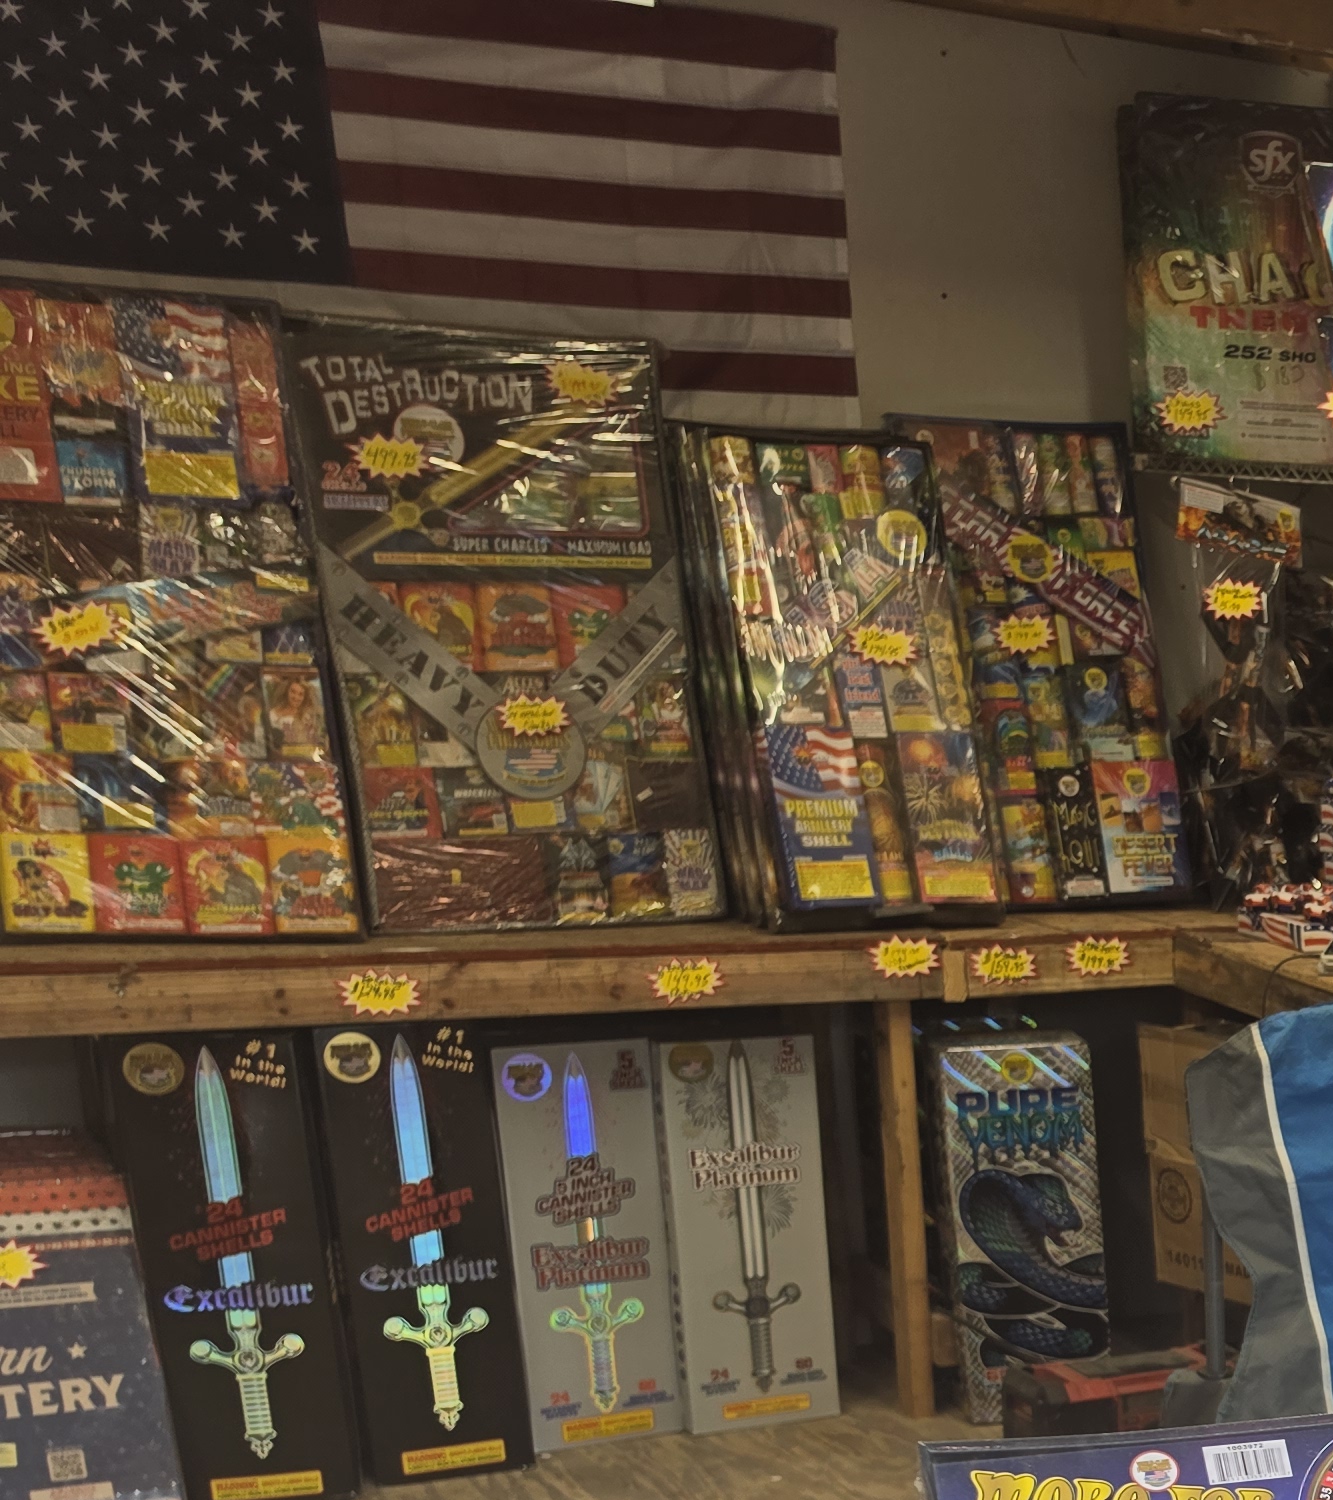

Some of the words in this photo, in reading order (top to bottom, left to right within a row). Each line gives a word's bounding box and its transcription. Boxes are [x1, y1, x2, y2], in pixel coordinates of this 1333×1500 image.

[1250, 140, 1296, 181] sfx
[1223, 344, 1273, 360] 252
[301, 353, 394, 388] TOTAL
[322, 369, 534, 436] DESTRUCTION
[340, 594, 486, 718] HEAVY
[579, 604, 671, 705] DUTY
[783, 799, 859, 819] PREMIUM
[801, 834, 852, 847] SHELL
[1112, 832, 1179, 855] DESERT
[258, 1060, 286, 1075] the
[448, 1044, 472, 1060] the
[956, 1087, 1081, 1120] PURE
[960, 1110, 1084, 1157] VENOM
[569, 1158, 598, 1177] 24
[688, 1143, 799, 1169] Excalibur
[401, 1178, 433, 1204] 24
[693, 1165, 799, 1190] Platinum
[207, 1200, 242, 1222] 24
[366, 1187, 474, 1233] CANNISTER
[538, 1181, 633, 1213] CANNISTER
[391, 1209, 461, 1242] SHELLS
[554, 1202, 619, 1224] SHELLS
[170, 1208, 286, 1250] CANNISTER
[197, 1229, 273, 1261] SHELLS
[533, 1239, 649, 1268] Excalibur
[360, 1257, 499, 1291] Excalibur
[538, 1259, 649, 1290] Platinum
[164, 1281, 314, 1313] Excalibur
